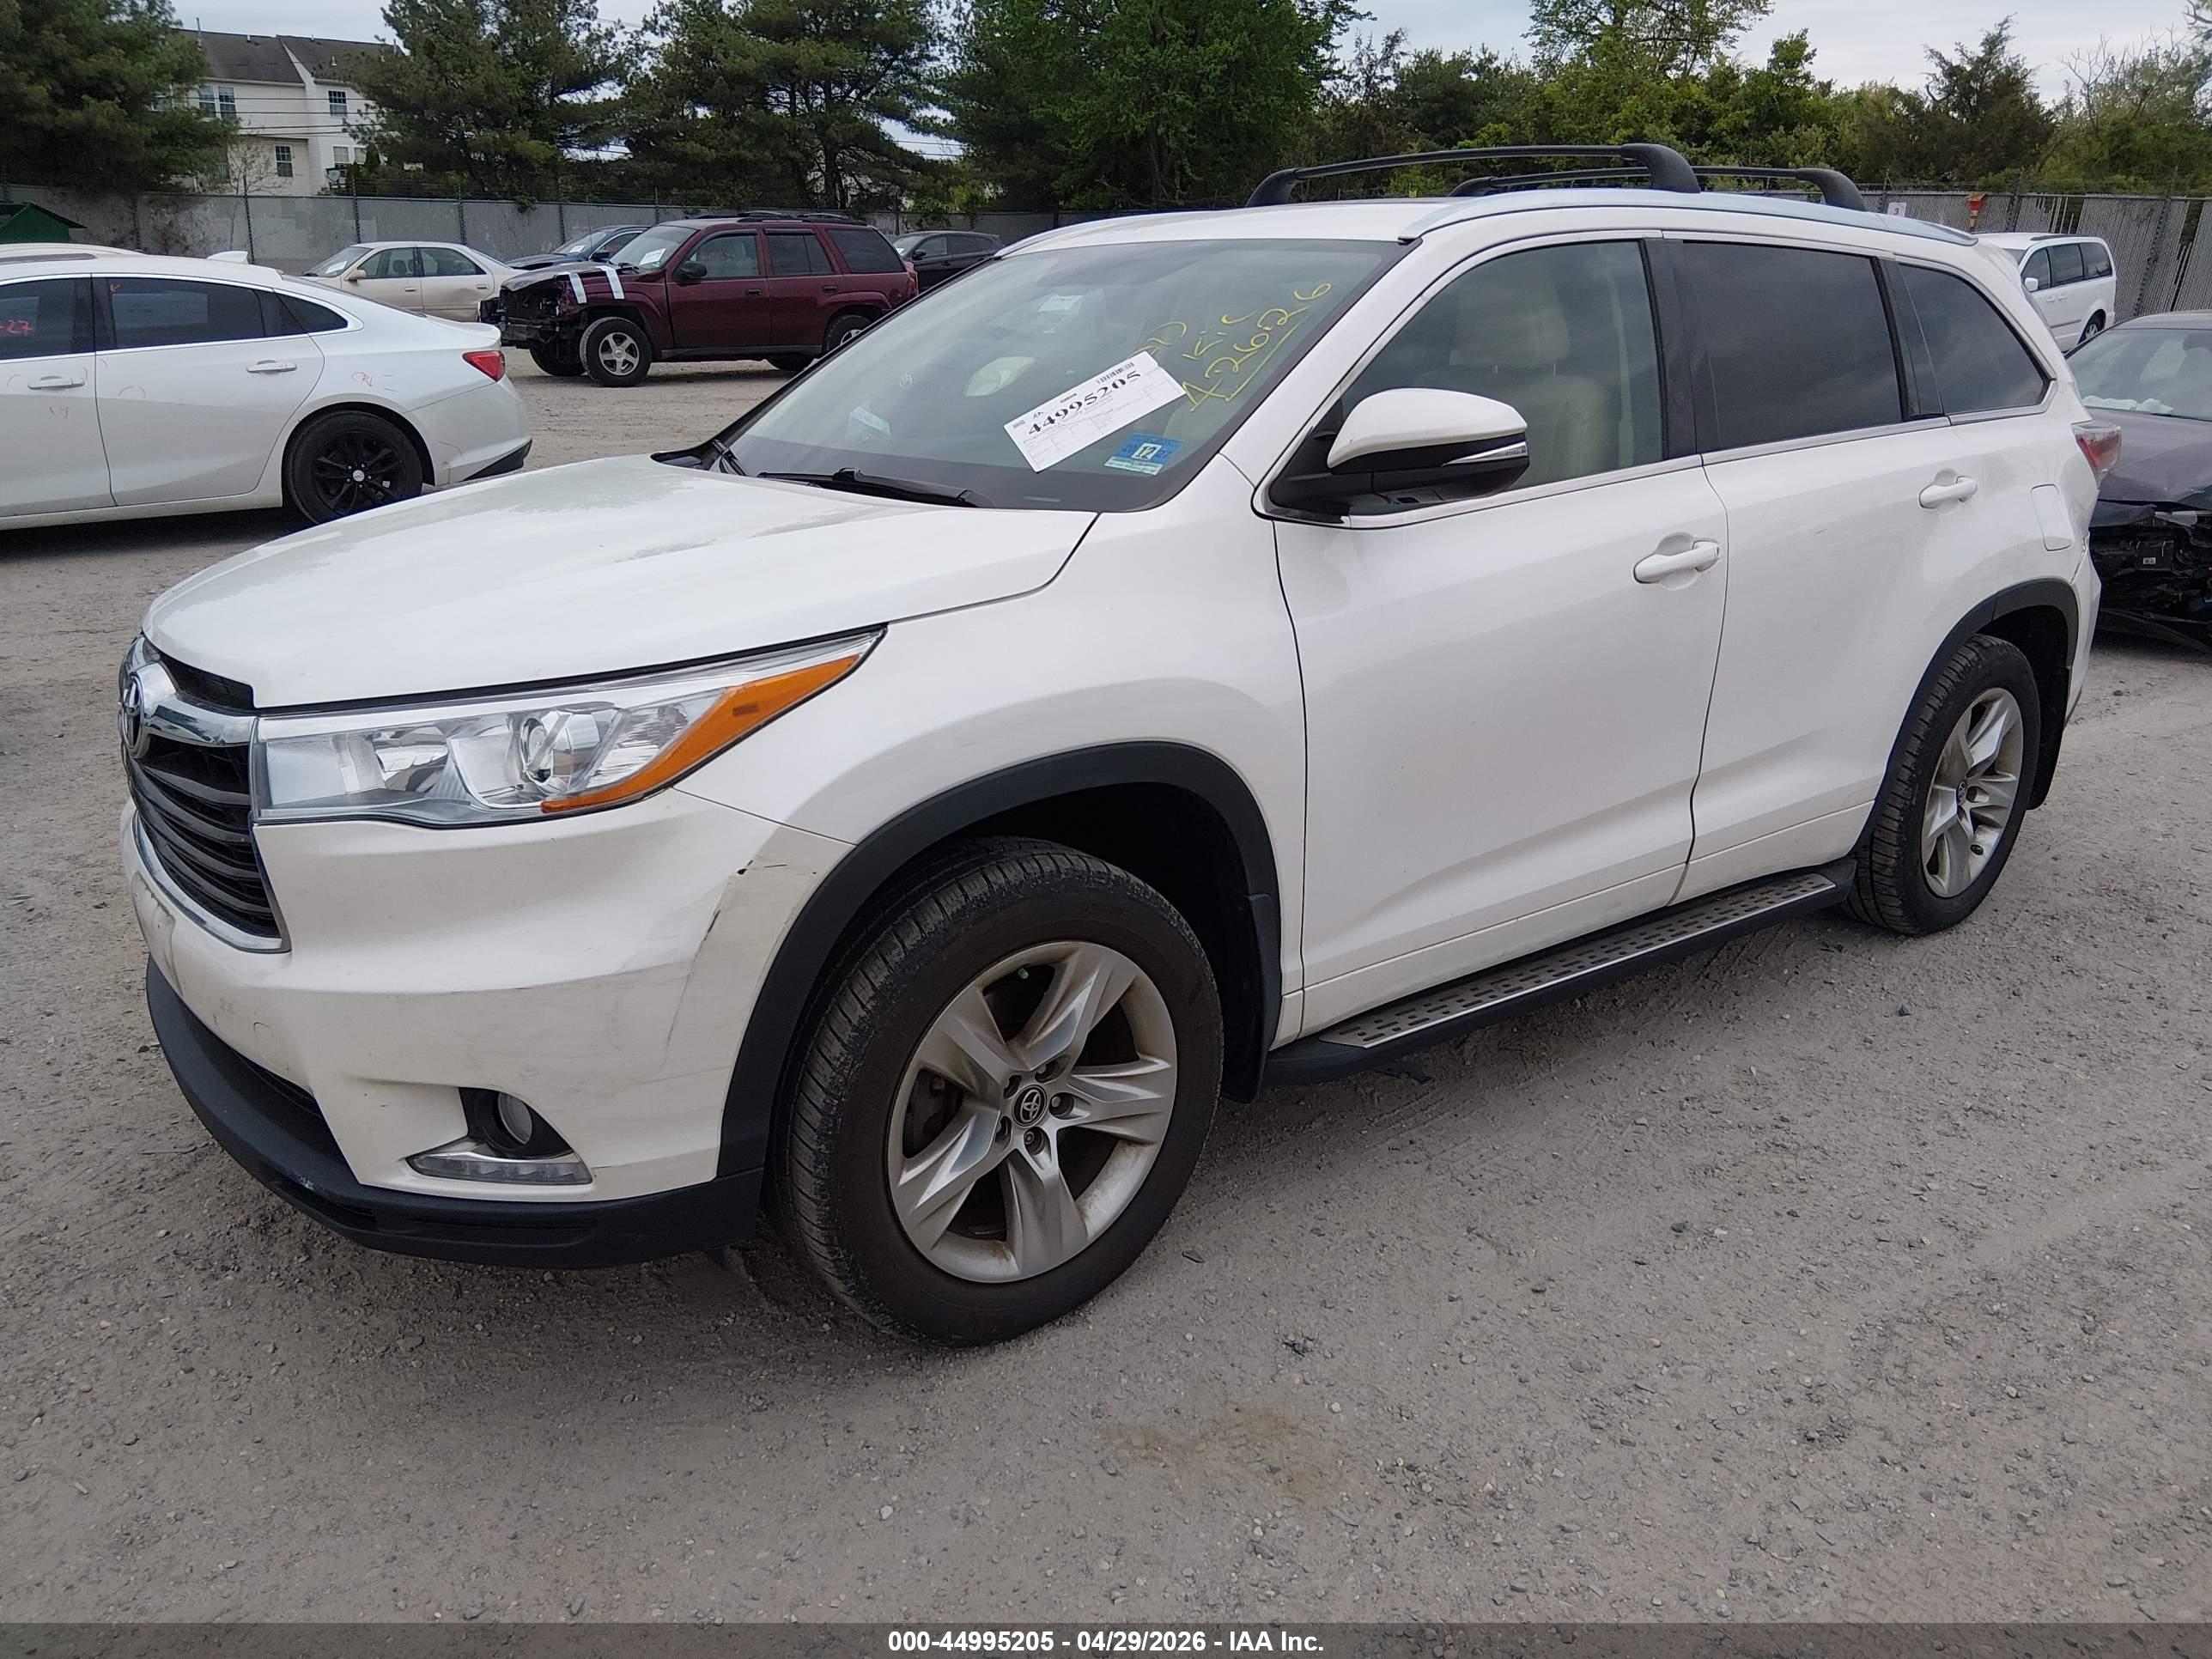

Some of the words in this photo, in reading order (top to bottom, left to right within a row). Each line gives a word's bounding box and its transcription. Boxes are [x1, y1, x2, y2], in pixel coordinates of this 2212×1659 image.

[1893, 208, 1899, 216] 3
[1028, 370, 1141, 434] 44995205
[1135, 446, 1156, 459] 12
